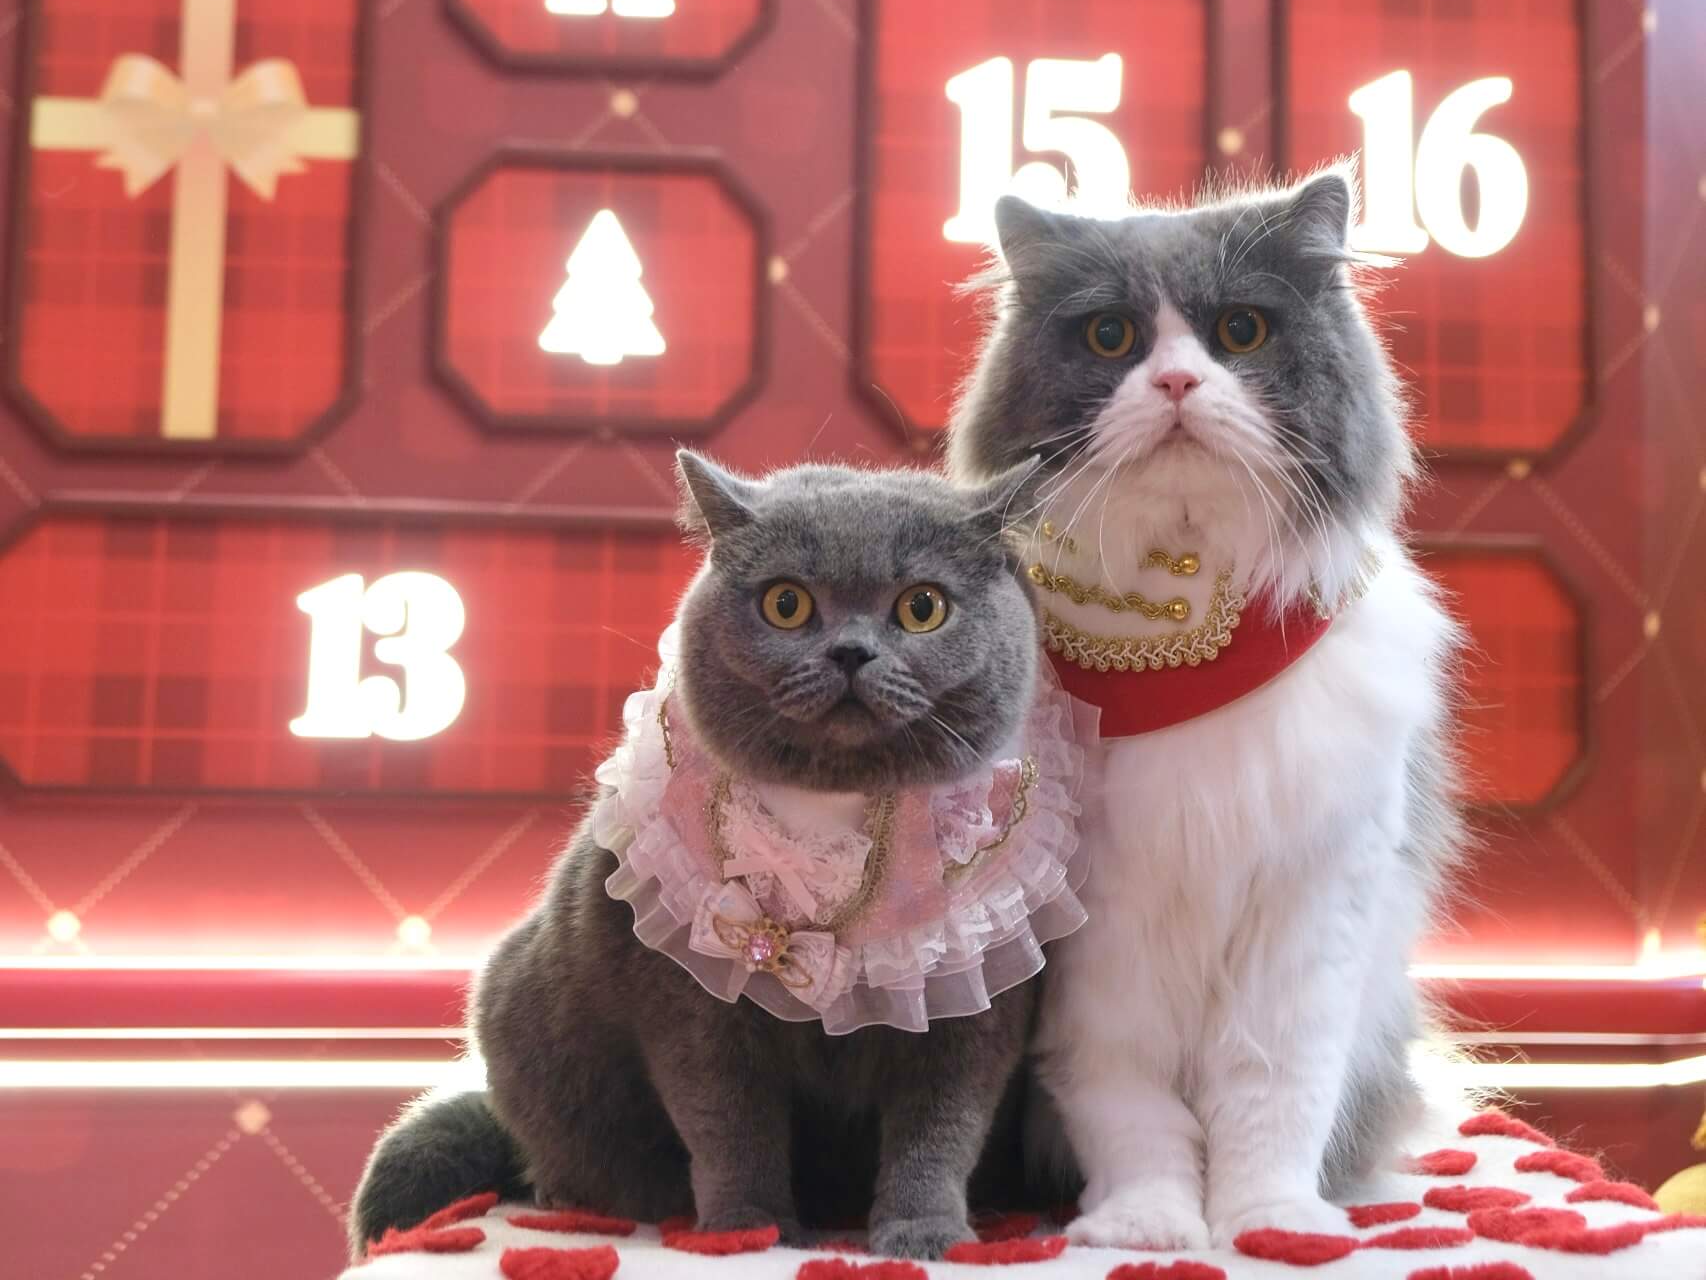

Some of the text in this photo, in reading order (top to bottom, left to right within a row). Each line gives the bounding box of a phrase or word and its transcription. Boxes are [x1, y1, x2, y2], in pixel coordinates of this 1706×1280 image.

[942, 52, 1130, 245] 15
[1347, 70, 1529, 259] 16
[289, 570, 466, 742] 13
